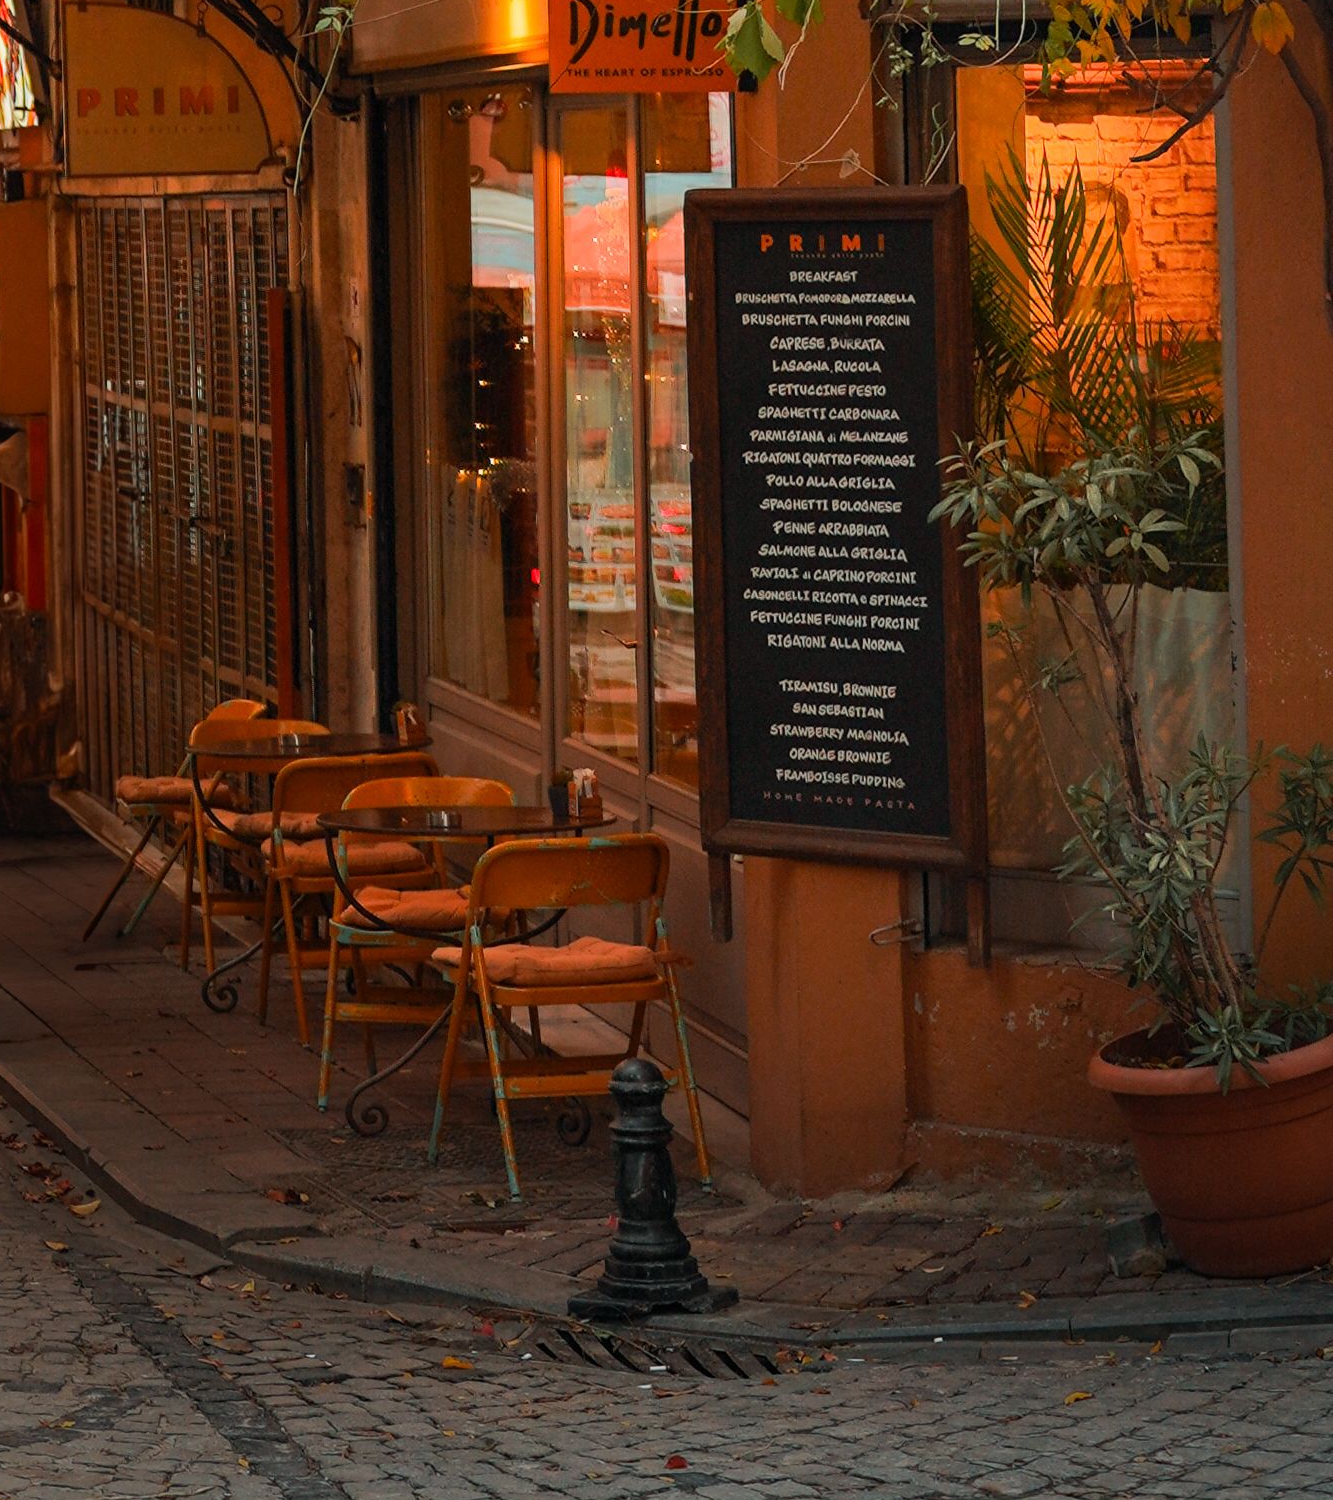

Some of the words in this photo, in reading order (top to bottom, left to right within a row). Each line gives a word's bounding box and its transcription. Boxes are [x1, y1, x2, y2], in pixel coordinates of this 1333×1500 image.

[567, 68, 589, 77] THE
[595, 68, 635, 77] HEART
[641, 68, 656, 76] OF
[77, 85, 239, 117] PRIMI
[760, 234, 885, 252] PRIMI
[789, 271, 858, 282] BREAKFAST
[735, 293, 797, 303] BRUSCHETTA
[851, 293, 916, 304] MOZZARELLA
[742, 314, 818, 325] BRUSCHETTA
[820, 315, 862, 325] FUNGHI
[865, 315, 910, 326] PORCINI
[835, 360, 881, 373] RUCOLA
[768, 384, 846, 396] FETTUCCINE
[848, 385, 886, 397] PESTO
[758, 407, 826, 420] SPAGHETTI
[828, 408, 900, 420] CARBONARA
[750, 430, 825, 443] PARMIGIANA
[827, 432, 836, 443] di
[840, 432, 908, 443] MELANZANE
[743, 451, 801, 464] RIGATONI
[803, 453, 851, 468] QUATTRO
[853, 454, 916, 467] FORMAGGI
[766, 474, 803, 487] POLLO
[806, 475, 837, 489] ALLA
[838, 477, 895, 490] GRIGLIA
[759, 498, 828, 511] SPAGHETTI
[832, 499, 902, 513] BOLOGNESE
[773, 521, 816, 536] PENNE
[818, 522, 889, 537] ARRABBIATA
[758, 544, 816, 557] SALMONE
[818, 547, 848, 558] ALLA
[851, 547, 908, 562] GRIGLIA
[751, 567, 799, 578] RAVIOLI
[802, 571, 811, 580] di
[813, 569, 865, 582] CAPRINO
[867, 572, 916, 584] PORCINI
[744, 589, 809, 601] CASONCELLI
[812, 593, 859, 604] RICOTTA
[870, 595, 928, 607] SPINACCI
[751, 610, 822, 625] FETTUCCINE
[824, 614, 867, 627] FUNGHI
[871, 616, 920, 630] PORCINI
[767, 634, 826, 648] RIGATONI
[830, 637, 860, 650] ALLA
[862, 638, 905, 653] NORMA
[843, 683, 896, 698] BROWNIE
[793, 703, 816, 715] SAN
[818, 704, 884, 720] SEBASTIAN
[770, 724, 844, 740] STRAWBERRY
[847, 729, 909, 746] MAGNOLIA
[789, 748, 836, 761] ORANGE
[837, 750, 891, 764] BROWNIE
[776, 769, 849, 784] FRAMBOISSE
[852, 774, 906, 788] PUDDING
[763, 791, 802, 801] HOME
[814, 795, 853, 806] MADE
[865, 798, 916, 809] PASTA
